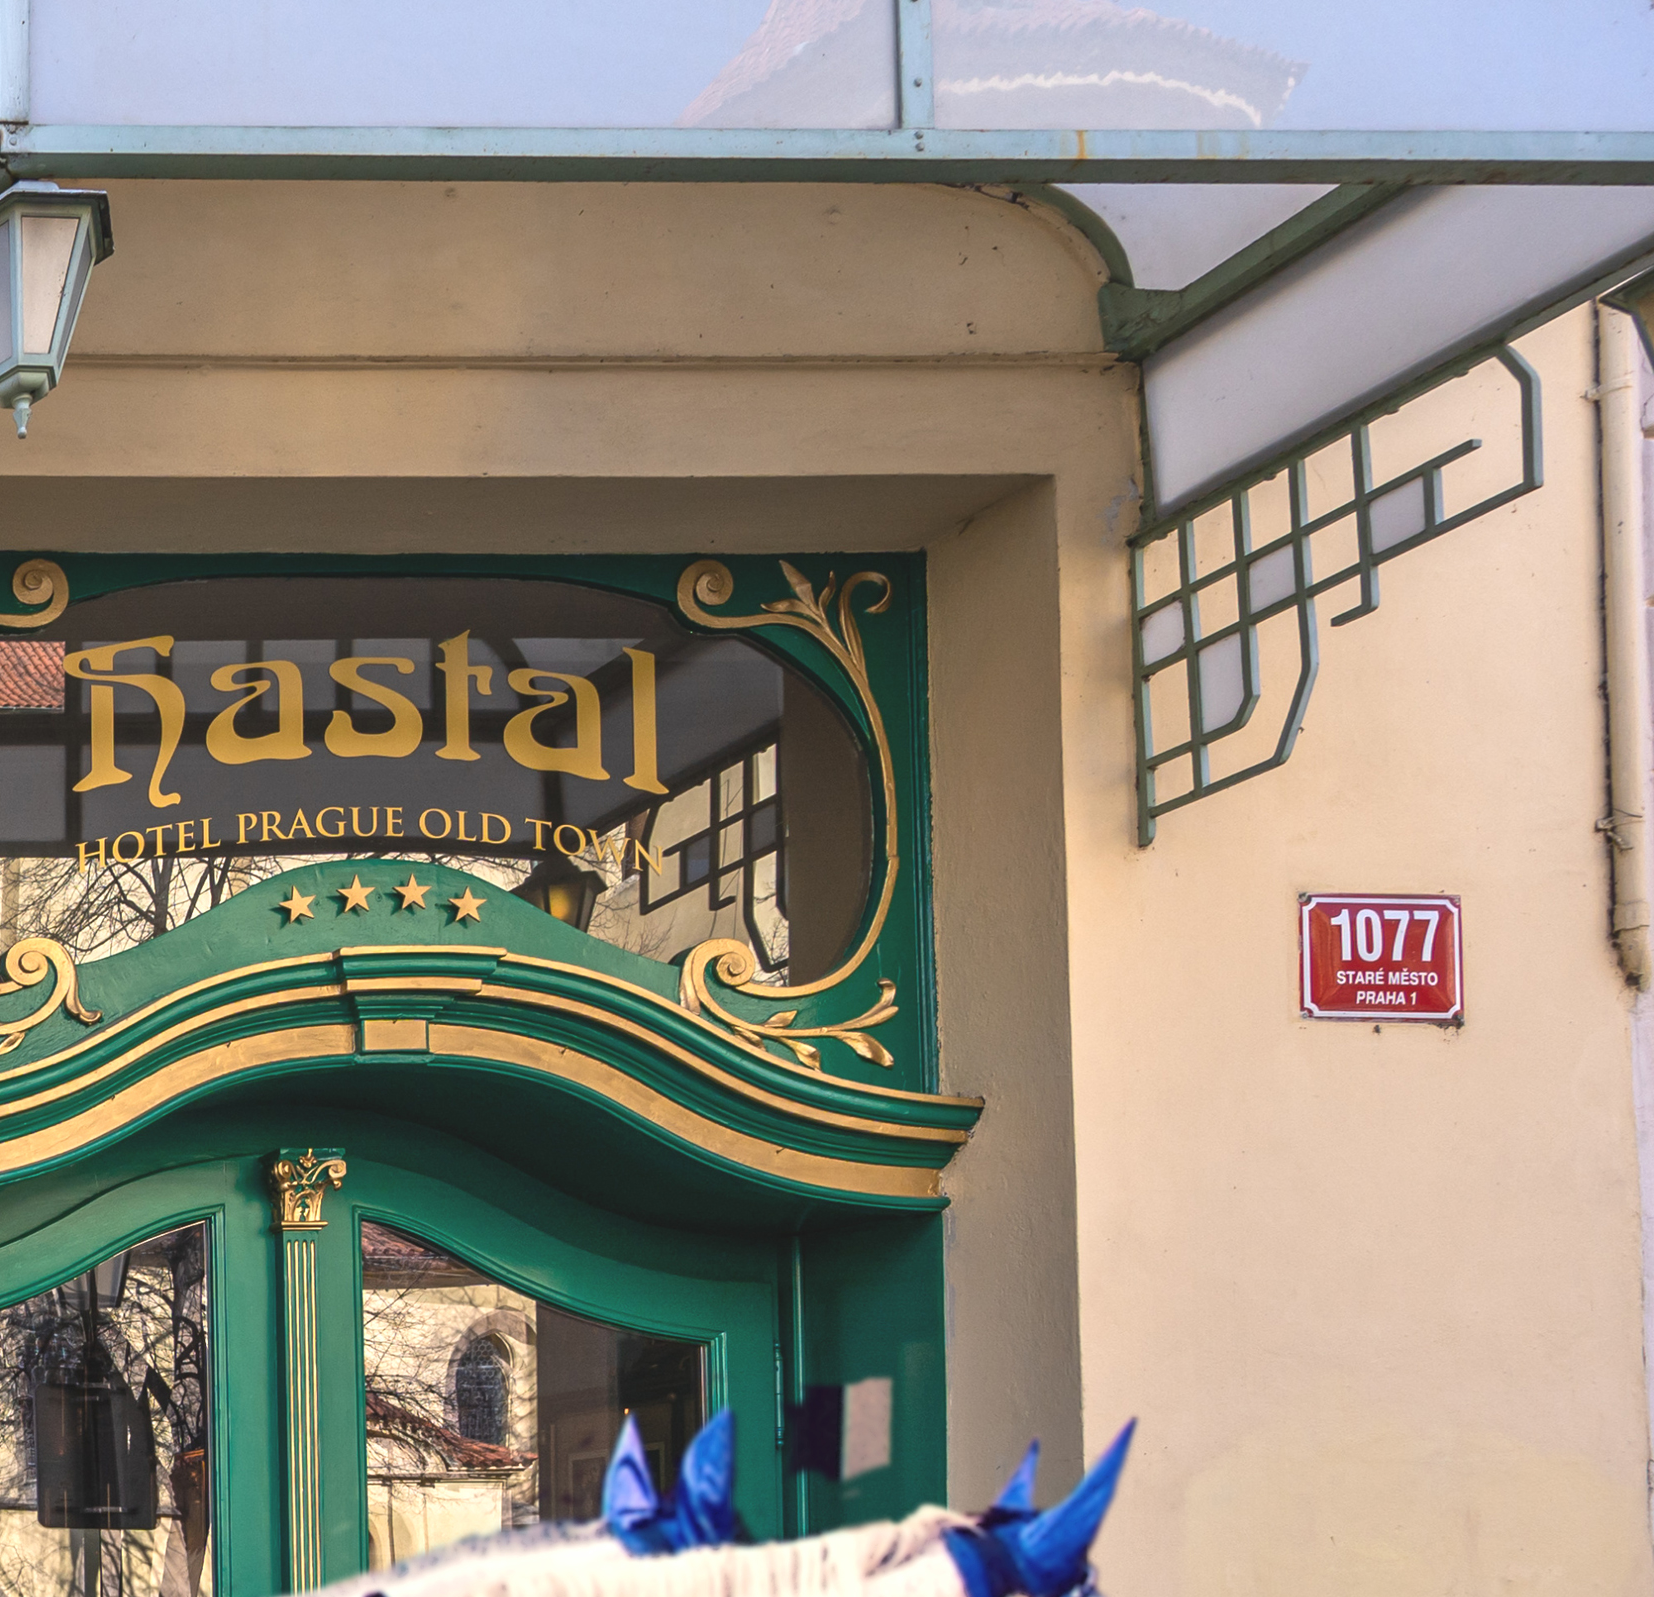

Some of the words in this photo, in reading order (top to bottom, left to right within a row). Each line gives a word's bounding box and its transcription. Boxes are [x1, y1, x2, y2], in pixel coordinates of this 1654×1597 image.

[75, 817, 221, 876] HOTEL
[235, 806, 406, 846] PRAGUE
[417, 807, 511, 848] OLD
[524, 819, 666, 878] TOWN
[1330, 908, 1440, 962] 1077
[1336, 967, 1385, 985] STARÉ
[1388, 967, 1439, 986] MĚSTO
[1355, 990, 1407, 1005] PRAHA
[1410, 991, 1418, 1005] 1
